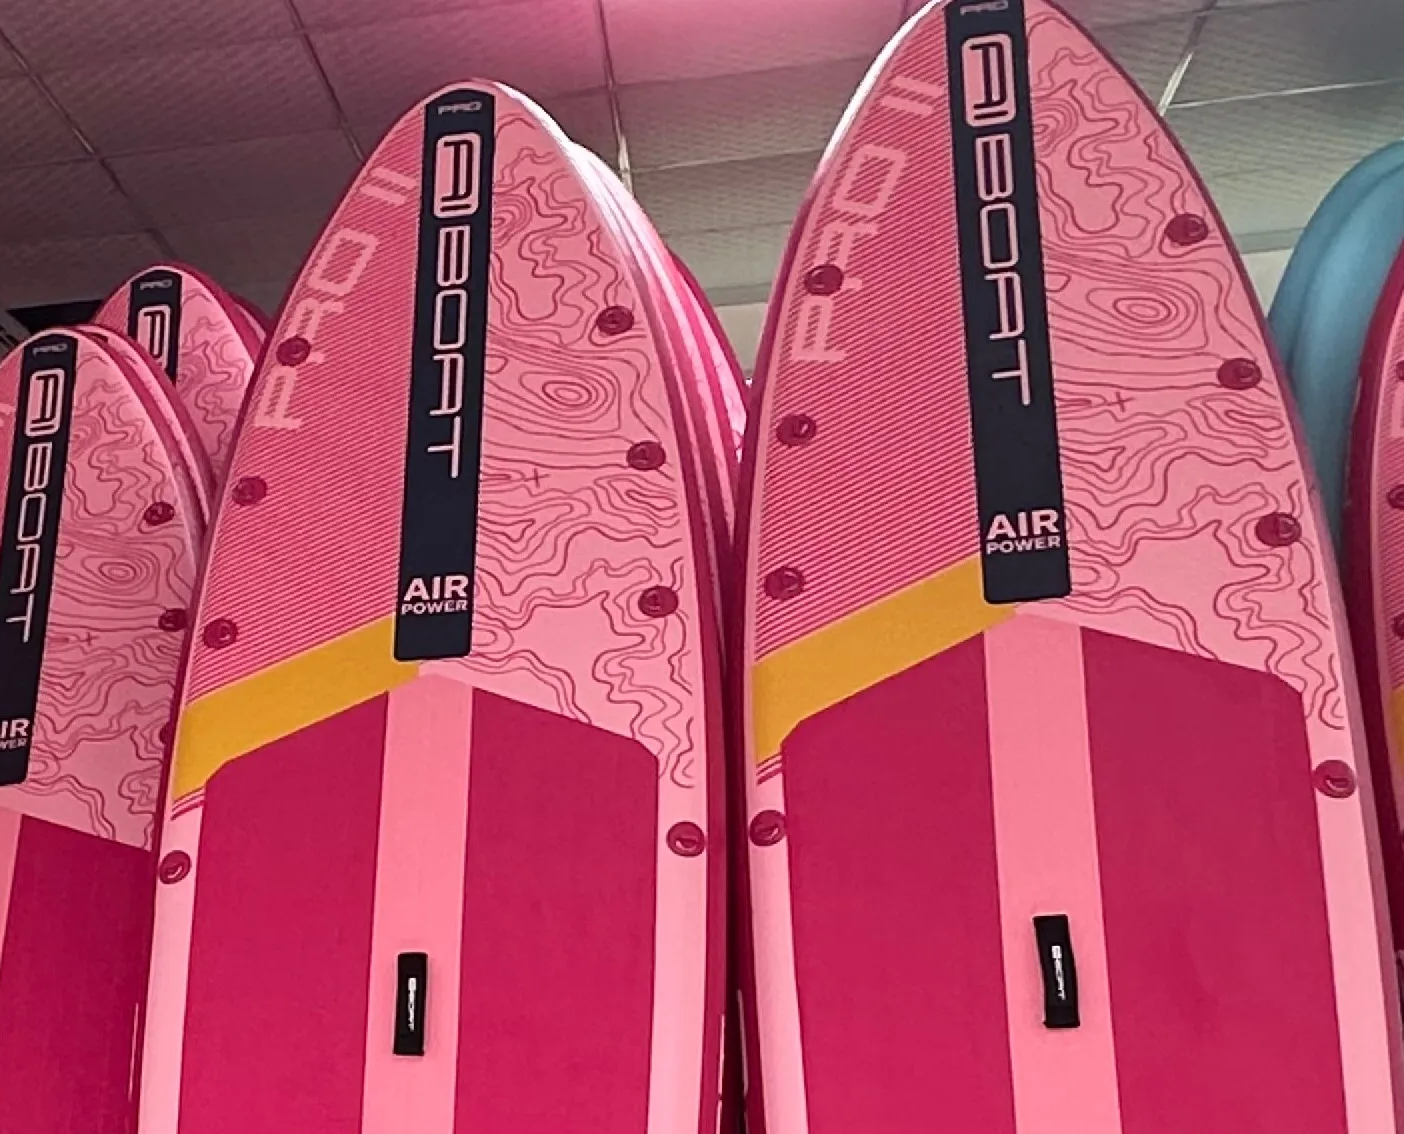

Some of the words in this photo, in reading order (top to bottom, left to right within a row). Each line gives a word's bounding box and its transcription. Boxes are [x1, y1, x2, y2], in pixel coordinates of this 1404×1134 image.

[987, 508, 1060, 539] AIR
[986, 535, 1061, 555] POWER
[403, 575, 469, 601] AIR
[401, 600, 468, 615] POWER
